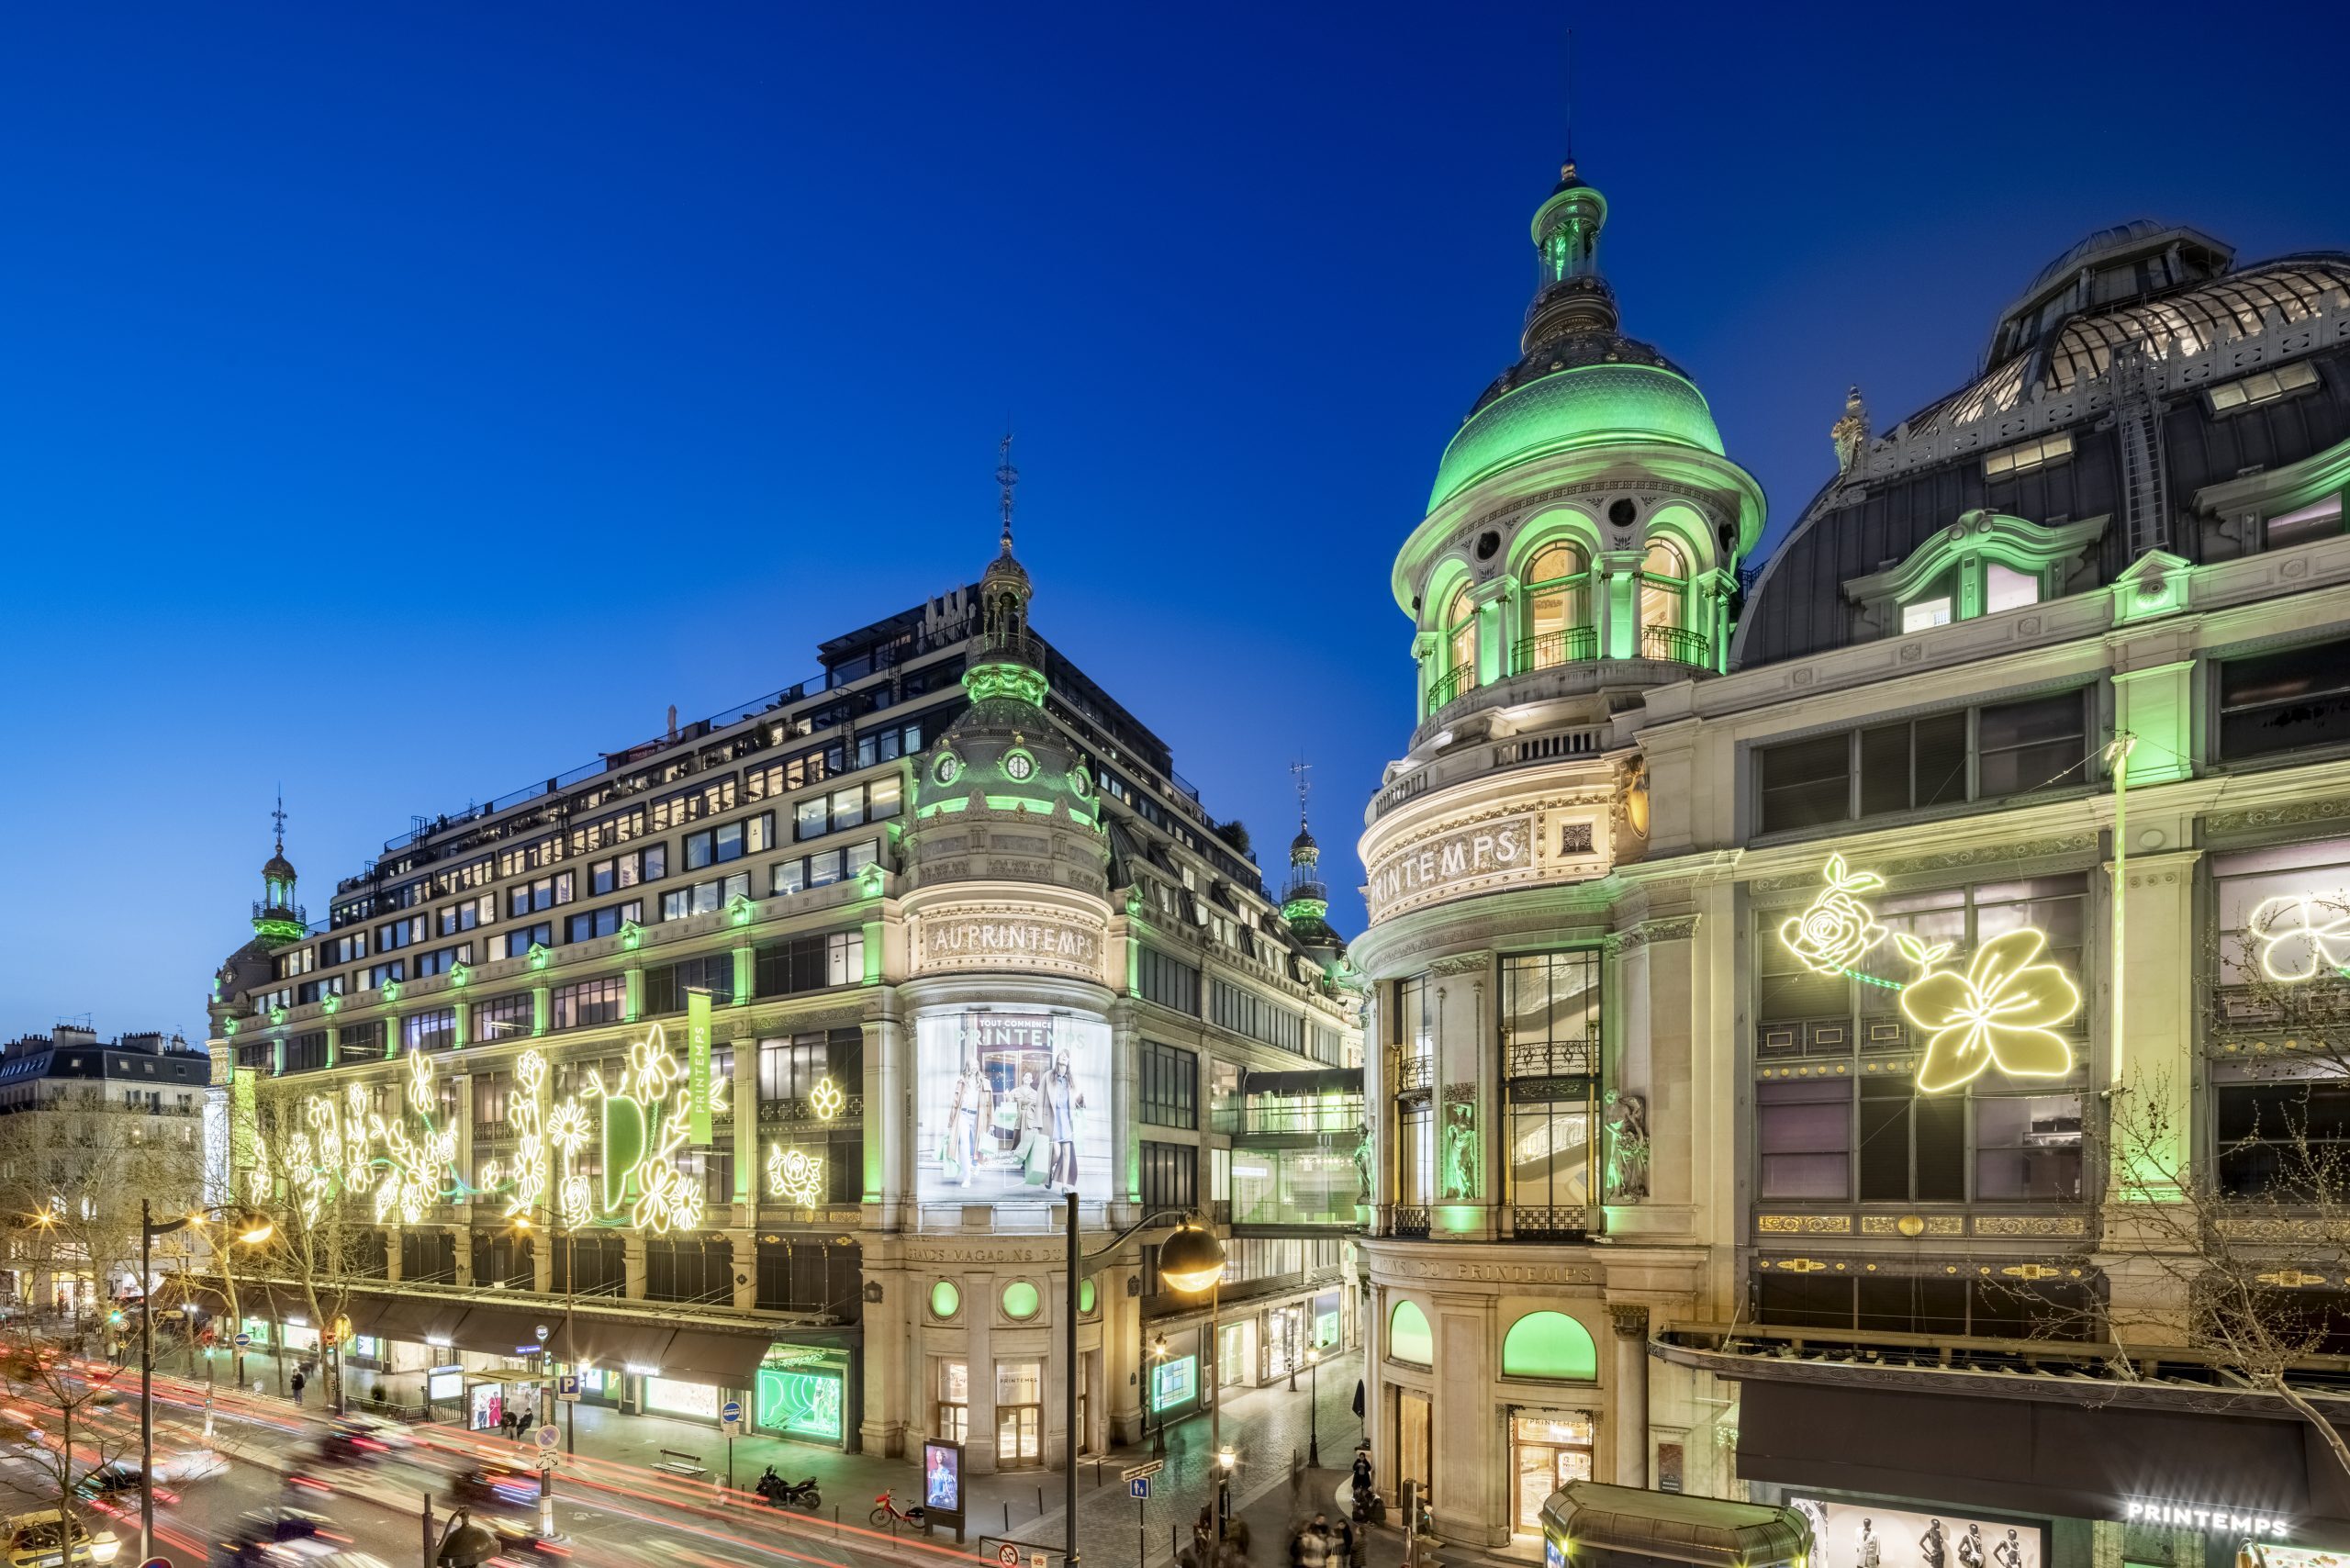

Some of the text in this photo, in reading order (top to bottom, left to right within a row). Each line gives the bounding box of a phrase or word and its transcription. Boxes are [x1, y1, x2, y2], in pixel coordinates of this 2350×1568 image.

[1371, 830, 1516, 912] PRINTEMPS
[934, 924, 1094, 959] AU PRINTEMPS
[695, 1025, 705, 1114] PRINTEMPS
[1419, 1261, 1439, 1277] DU
[1458, 1263, 1594, 1283] PRINTEMPS
[564, 1377, 575, 1393] P
[1529, 1418, 1581, 1428] PRINTEMPS
[928, 1471, 956, 1483] LANVIN
[2127, 1502, 2288, 1537] PRINTEMPS
